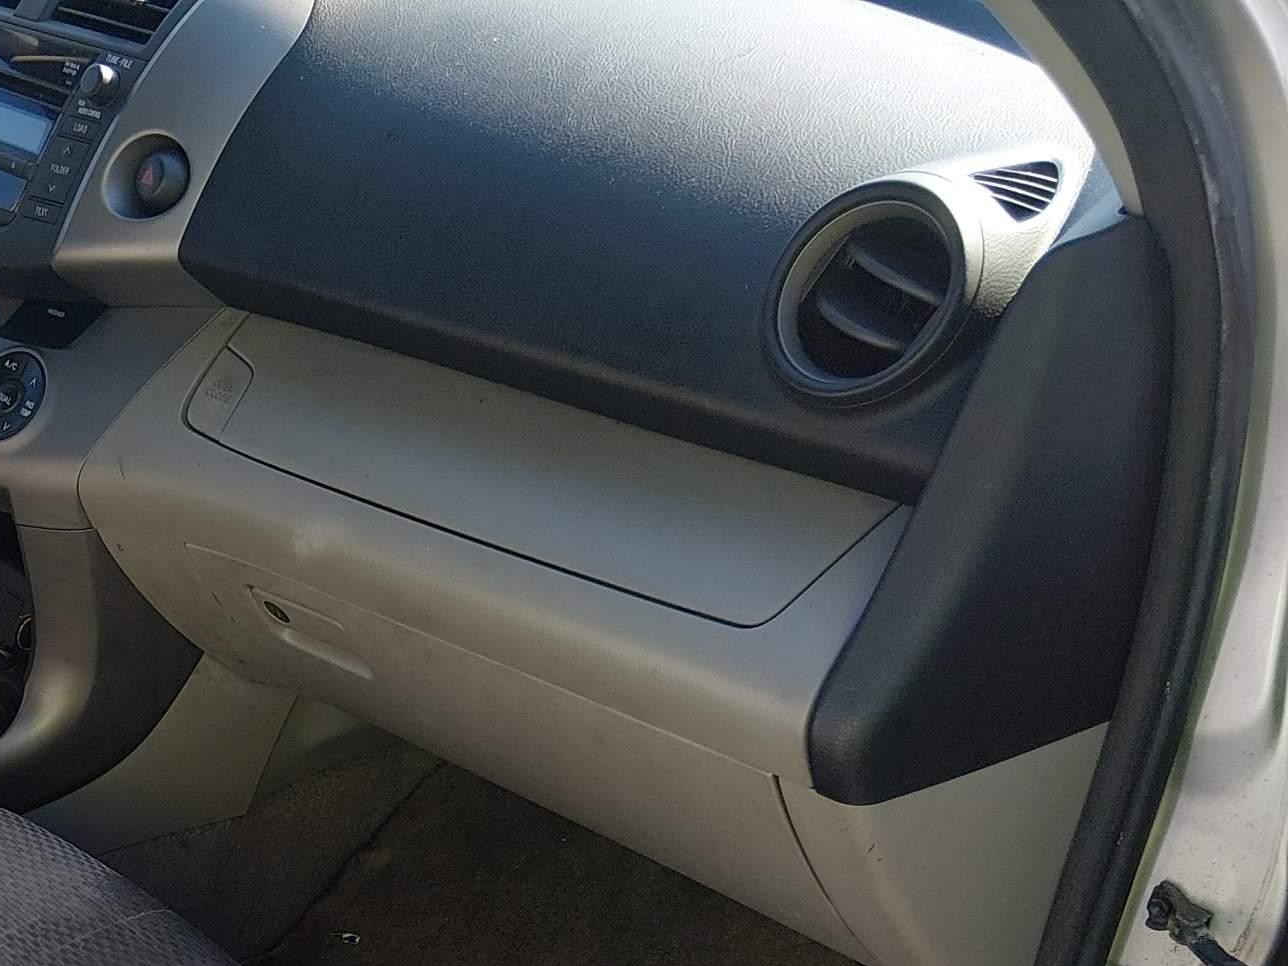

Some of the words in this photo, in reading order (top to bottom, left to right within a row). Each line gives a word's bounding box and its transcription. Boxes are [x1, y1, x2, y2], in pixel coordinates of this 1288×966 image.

[73, 122, 88, 134] LOAD
[51, 163, 70, 175] FOLDER
[35, 206, 49, 217] TEXT
[4, 359, 18, 371] A/C
